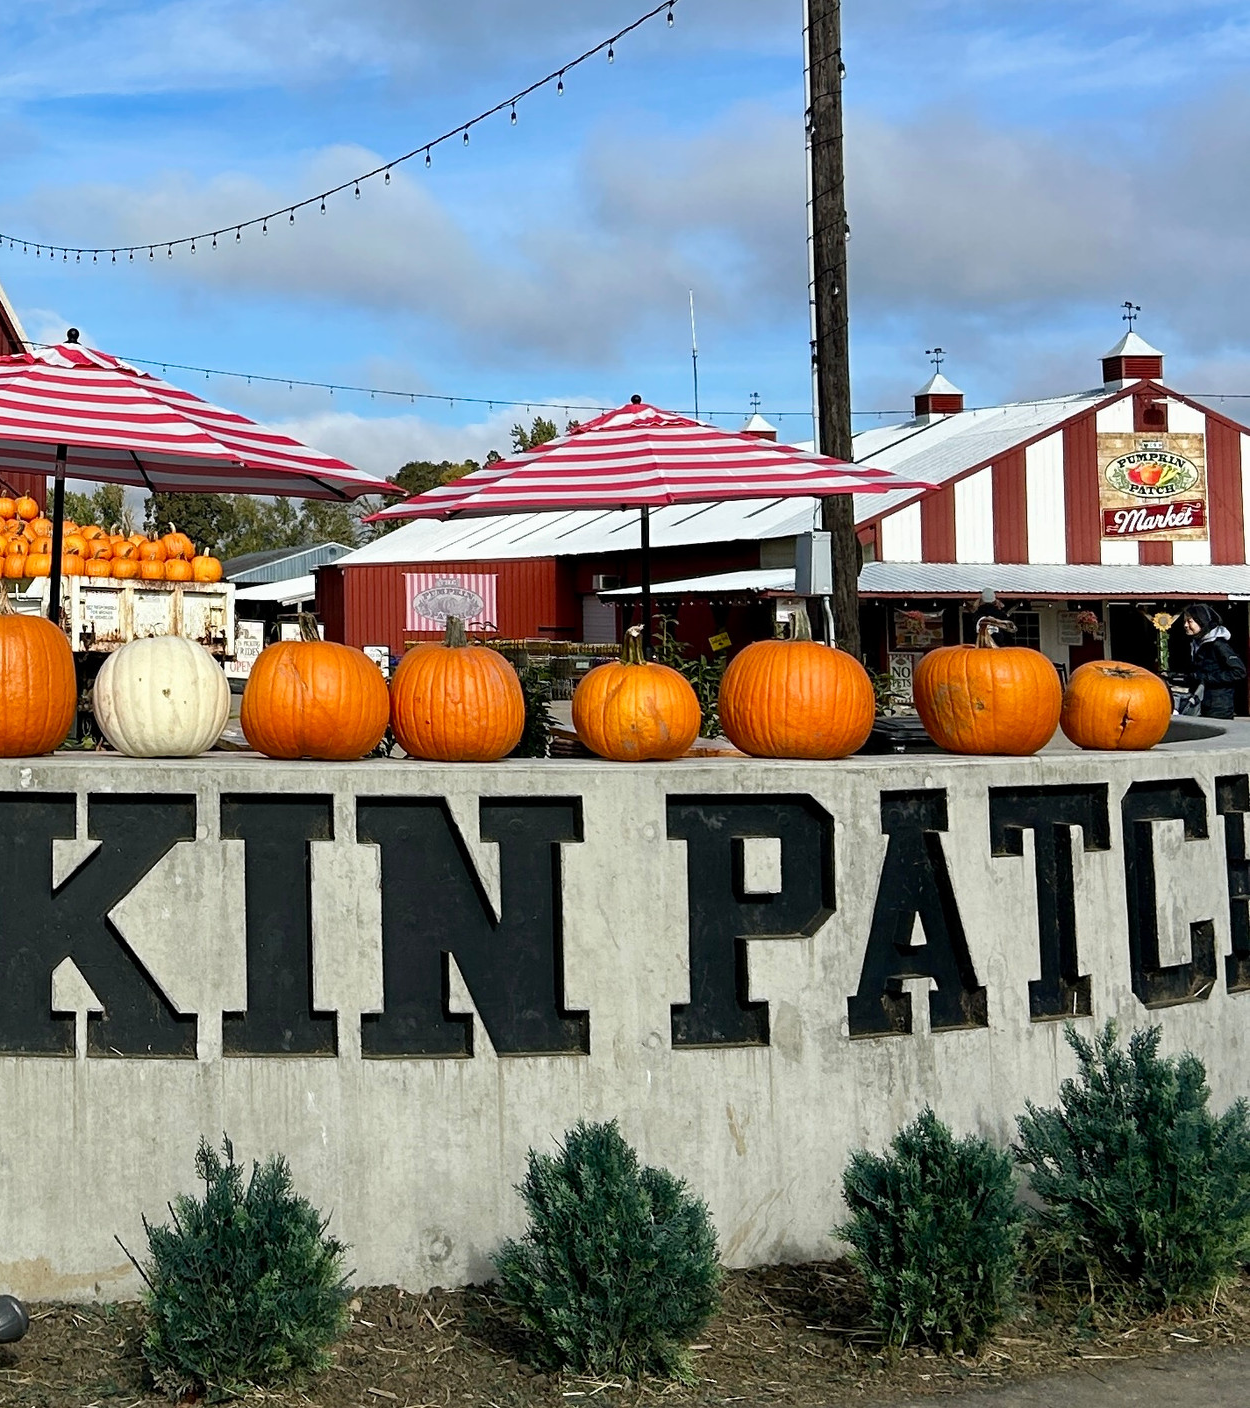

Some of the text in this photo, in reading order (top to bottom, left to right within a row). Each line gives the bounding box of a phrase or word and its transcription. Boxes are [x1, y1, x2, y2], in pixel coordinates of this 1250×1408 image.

[1117, 453, 1186, 468] PUMPKIN
[1129, 483, 1176, 495] PATCH
[1114, 504, 1194, 534] Market
[422, 588, 475, 600] PUMPKIN
[892, 666, 910, 678] NO
